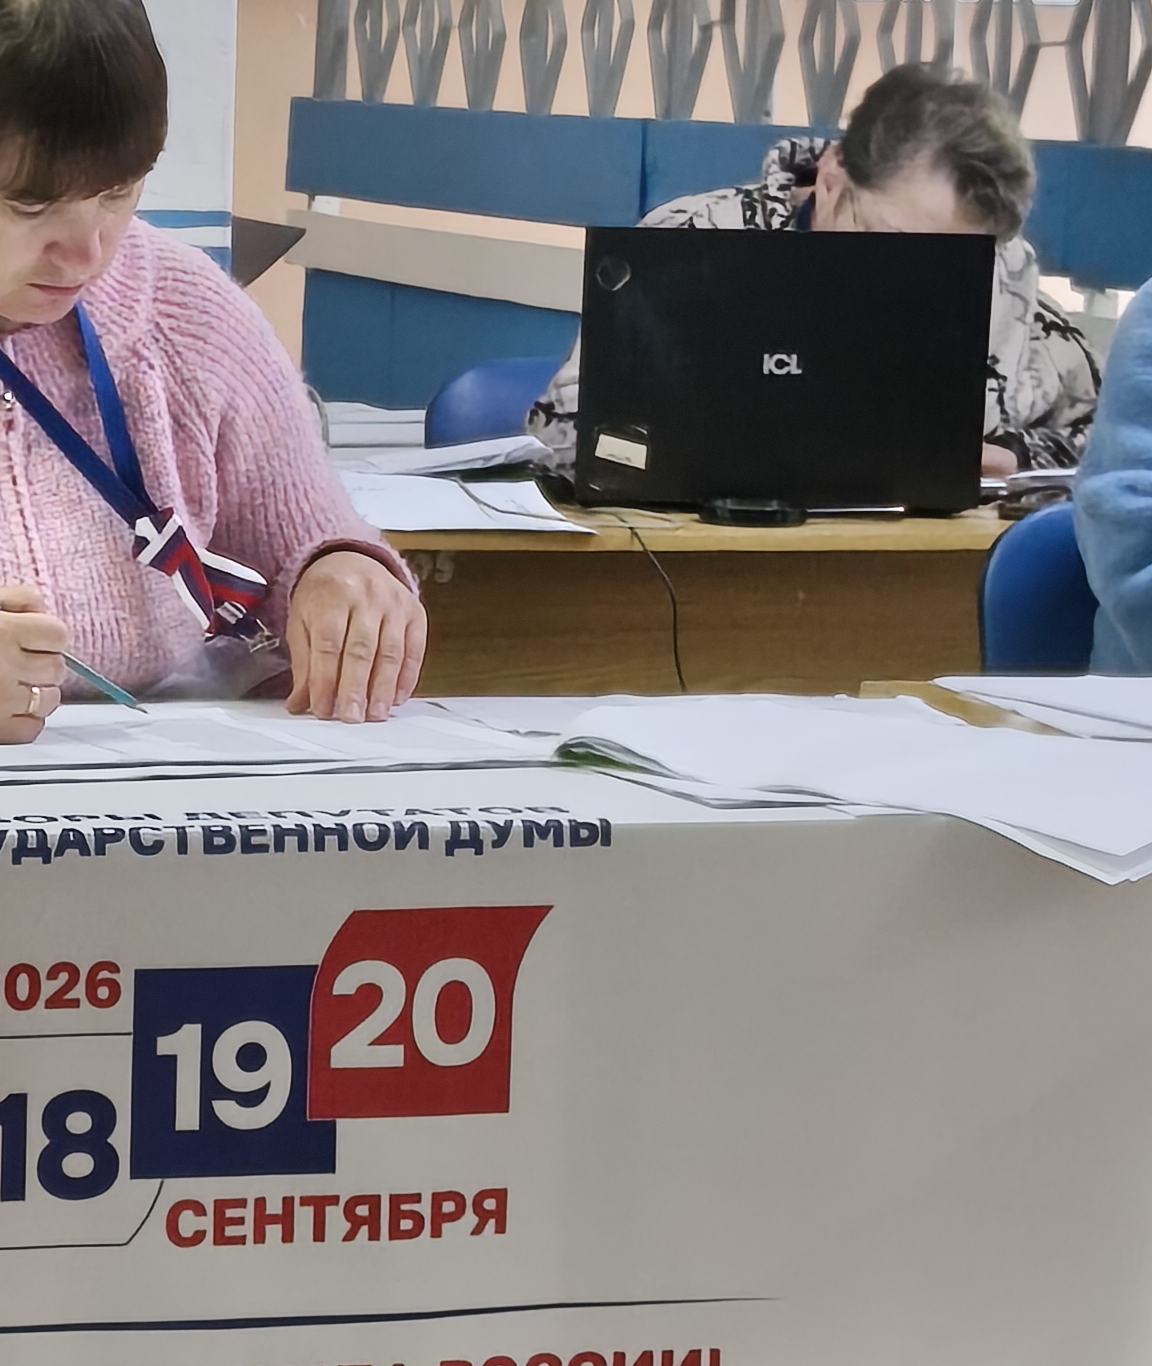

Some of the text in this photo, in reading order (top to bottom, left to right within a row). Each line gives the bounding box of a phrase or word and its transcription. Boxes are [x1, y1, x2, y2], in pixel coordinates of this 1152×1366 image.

[762, 353, 803, 375] ICL
[444, 817, 612, 857] ДУМЫ
[329, 956, 497, 1070] 20
[156, 1019, 293, 1131] 19
[165, 1187, 509, 1248] СЕНТЯБРЯ
